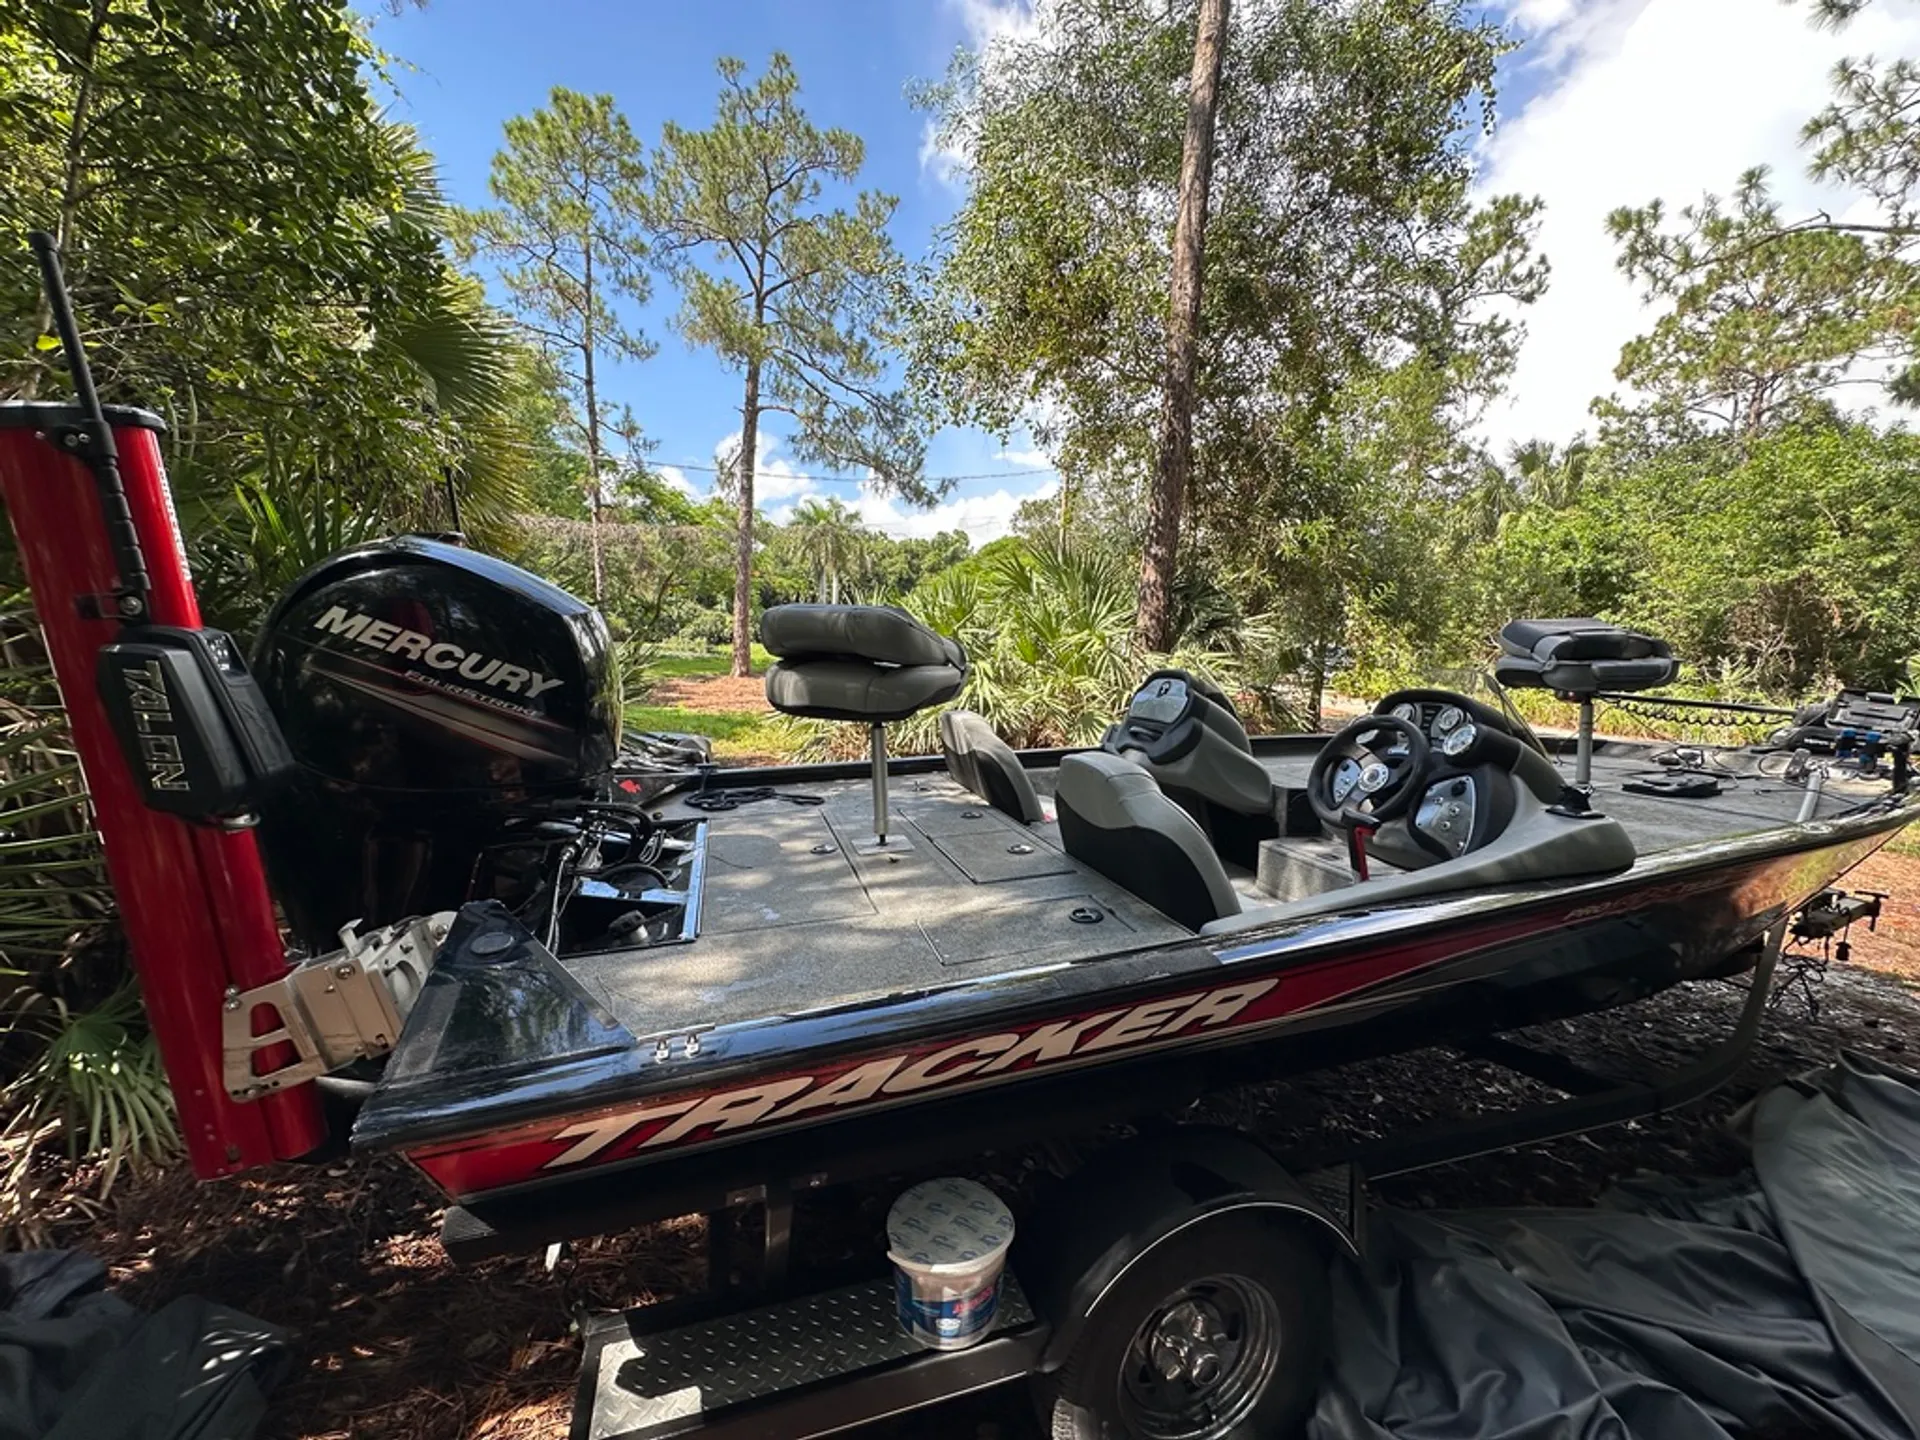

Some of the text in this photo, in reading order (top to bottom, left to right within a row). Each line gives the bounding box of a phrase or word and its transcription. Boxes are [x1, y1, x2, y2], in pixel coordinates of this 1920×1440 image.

[313, 605, 564, 699] MERCURY
[122, 660, 190, 791] TALON
[543, 977, 1279, 1169] TRACKER
